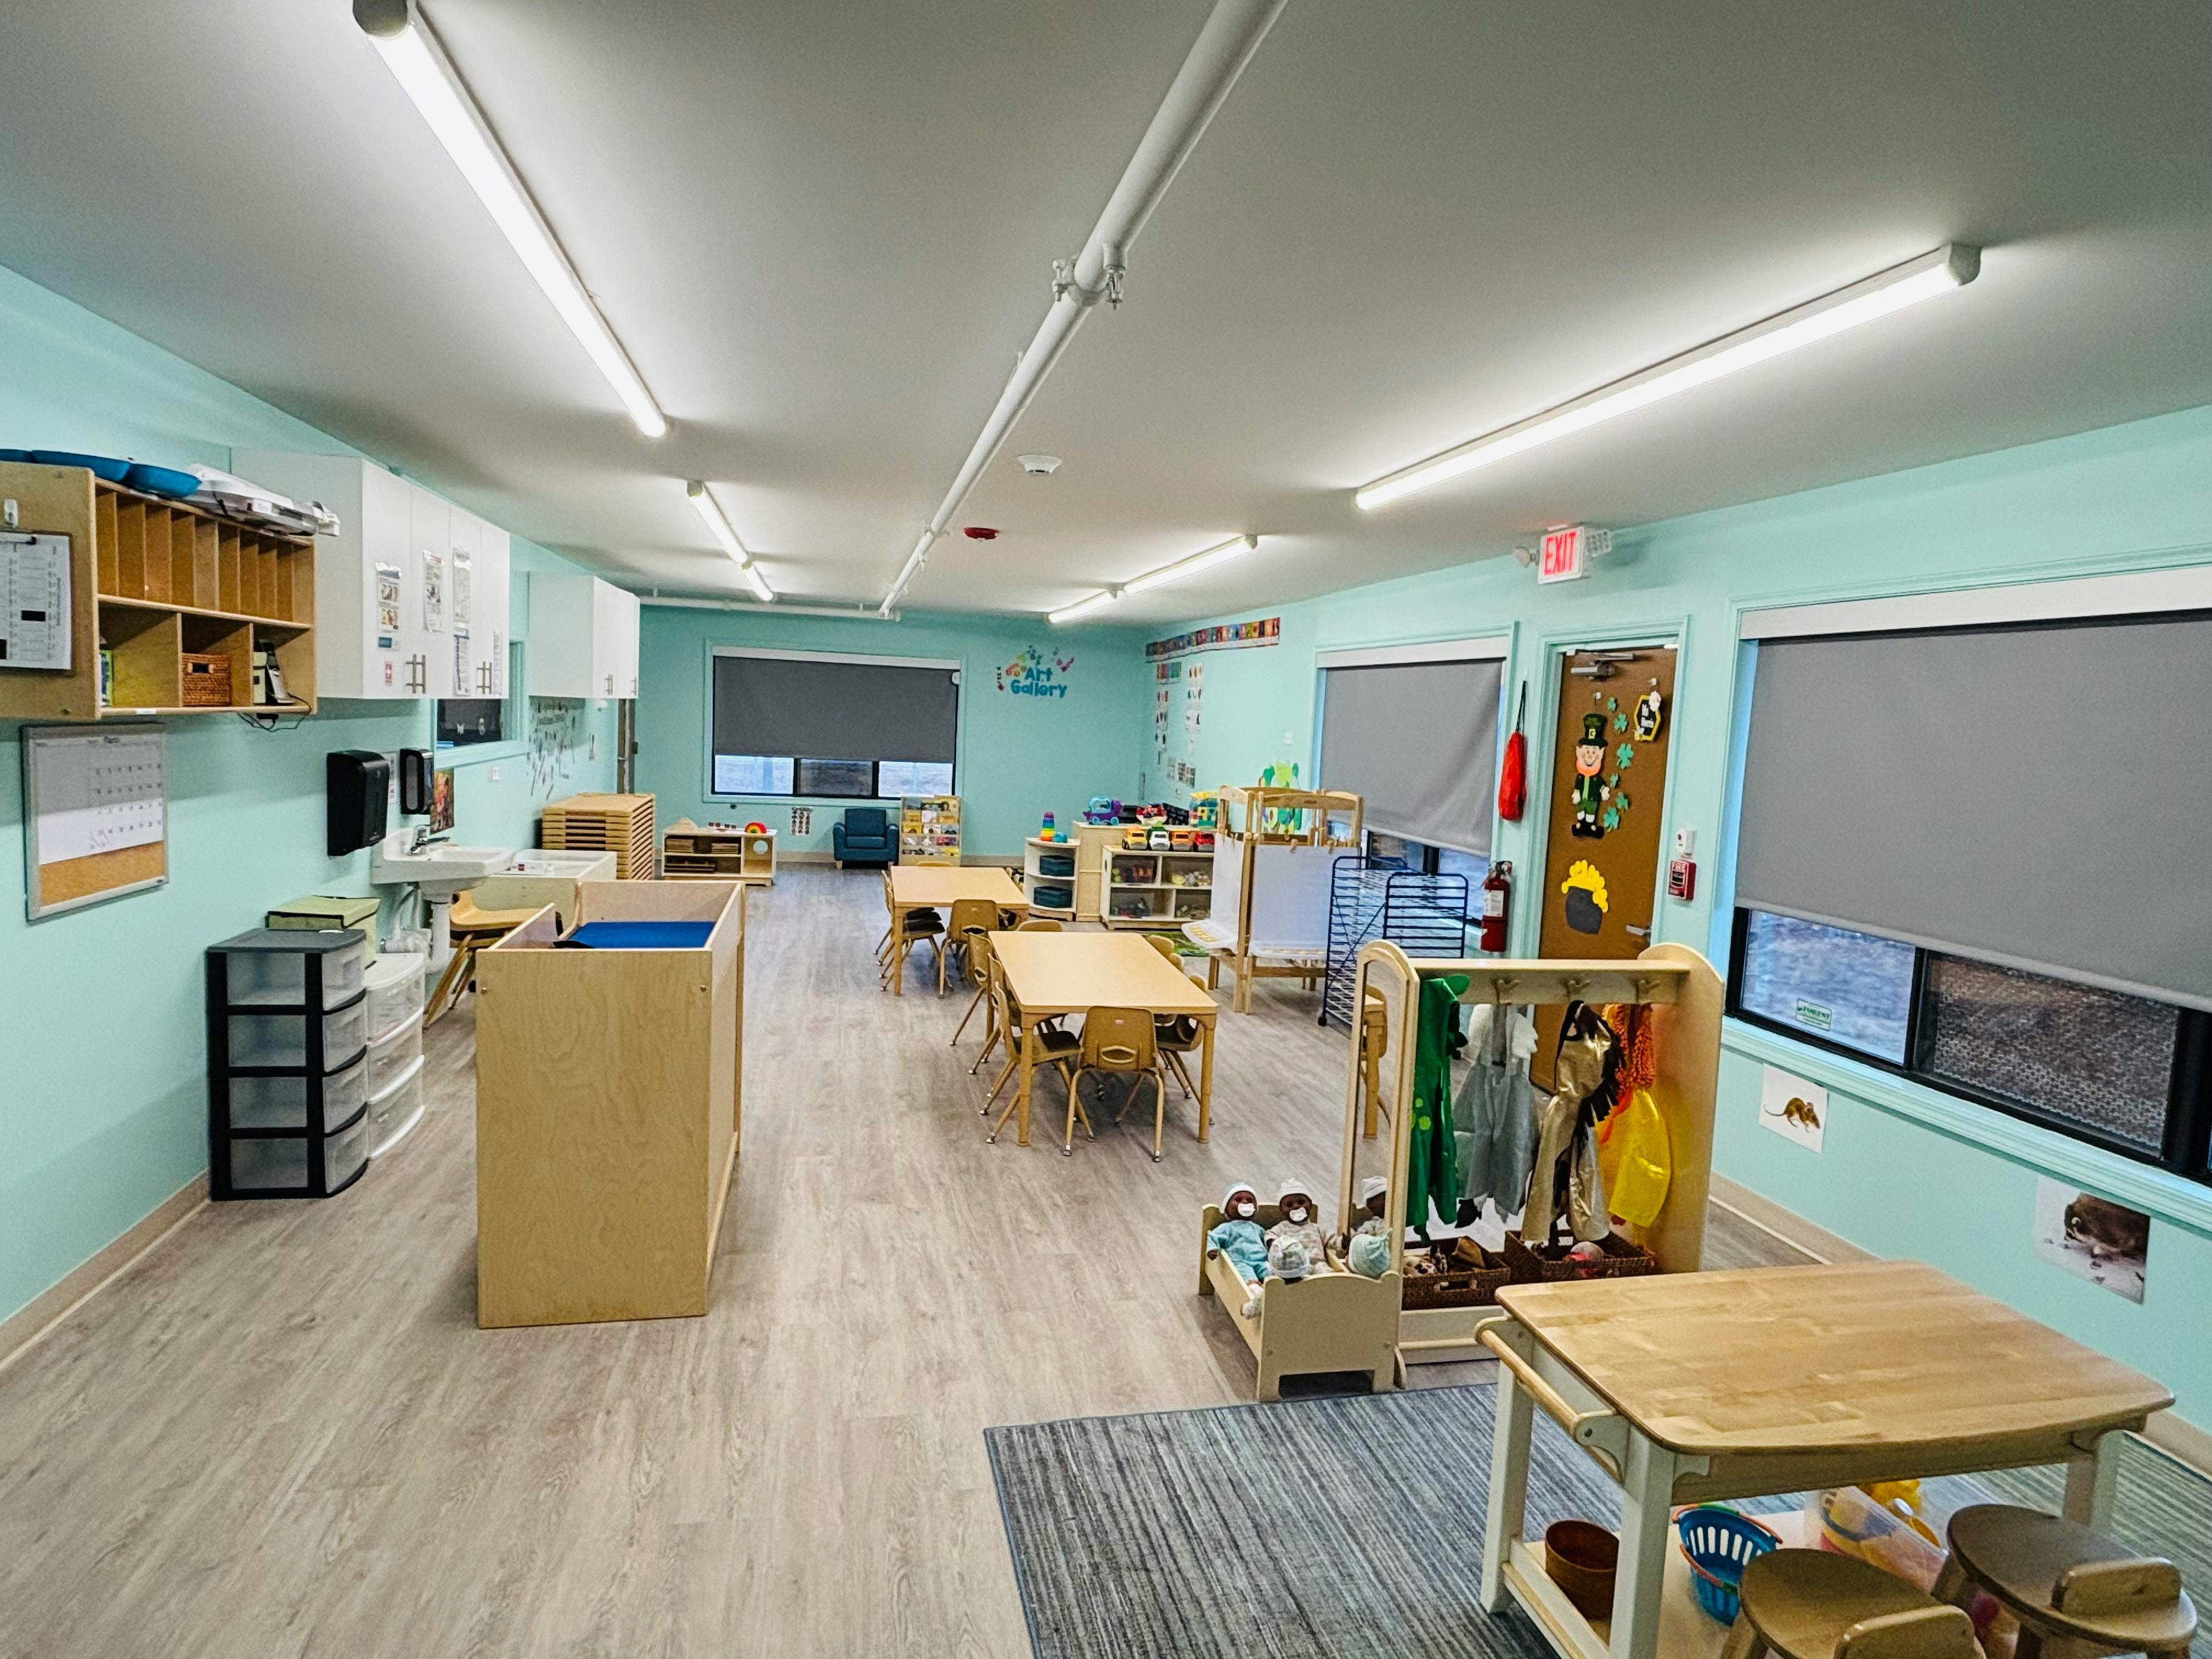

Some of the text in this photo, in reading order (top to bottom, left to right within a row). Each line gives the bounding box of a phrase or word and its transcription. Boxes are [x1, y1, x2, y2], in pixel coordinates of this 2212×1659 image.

[1544, 531, 1577, 575] EXIT
[1025, 667, 1053, 681] Art
[1011, 679, 1068, 698] Gallery
